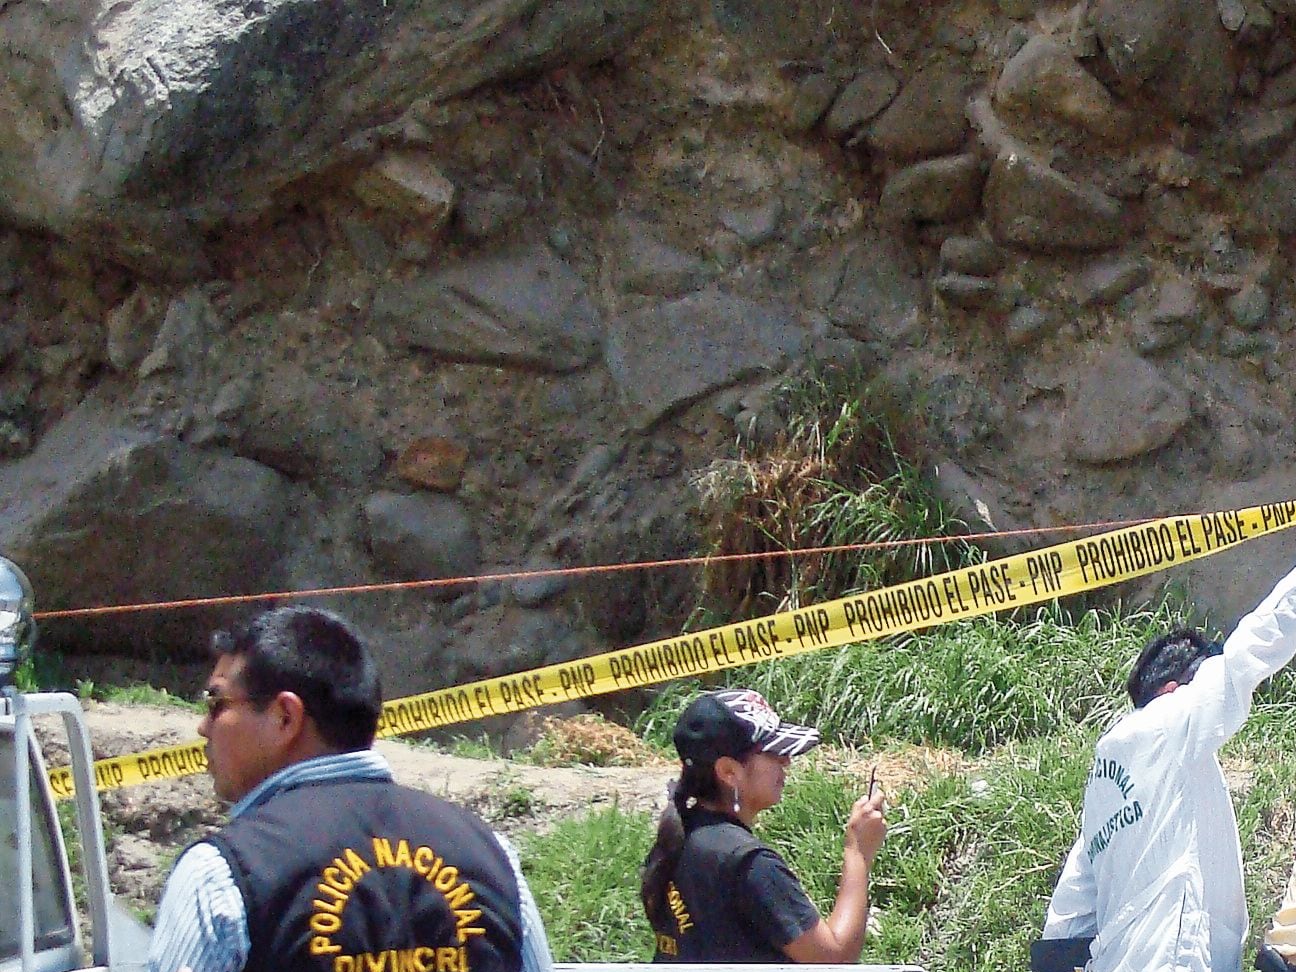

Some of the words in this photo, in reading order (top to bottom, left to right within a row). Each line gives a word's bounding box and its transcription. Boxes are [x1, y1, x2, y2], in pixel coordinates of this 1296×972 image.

[1075, 523, 1175, 584] PROHIBIDO
[1175, 518, 1201, 557] EL
[1200, 510, 1248, 551] PASE
[1260, 501, 1296, 531] PNP
[843, 580, 943, 637] PROHIBIDO
[942, 575, 969, 614] EL
[967, 563, 1016, 609] PASE
[1026, 551, 1063, 596] PNP
[474, 685, 495, 714] EL
[500, 674, 543, 711] PASE
[558, 663, 596, 699] PNP
[608, 636, 709, 688] PROHIBIDO
[709, 631, 735, 667] EL
[735, 619, 783, 660] PASE
[793, 608, 830, 648] PNP
[309, 848, 372, 956] POLICIA
[372, 837, 487, 943] NACIONAL
